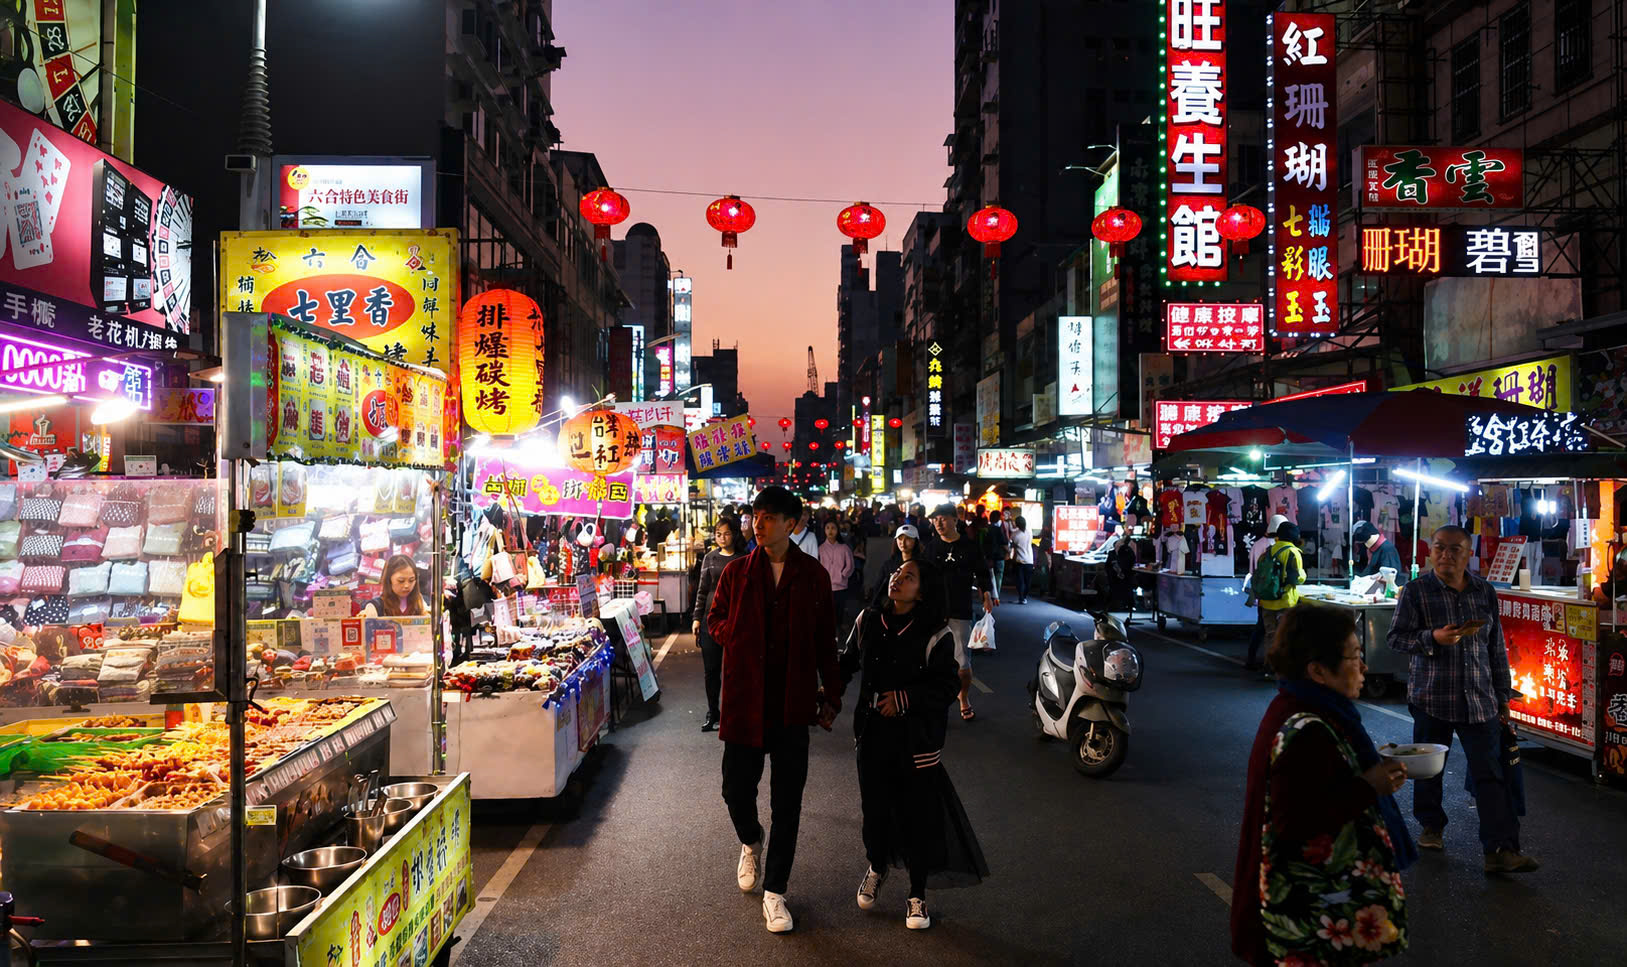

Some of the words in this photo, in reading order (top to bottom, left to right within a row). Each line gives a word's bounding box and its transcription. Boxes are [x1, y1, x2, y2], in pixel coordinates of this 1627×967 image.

[47, 26, 65, 52] 28
[1170, 0, 1224, 267] 旺養生館
[1281, 21, 1328, 191] 紅珊瑚
[309, 189, 408, 205] 六合特色美食街
[1382, 149, 1505, 205] 香雲
[1281, 205, 1304, 324] 七彩玉
[289, 288, 394, 326] 七里香
